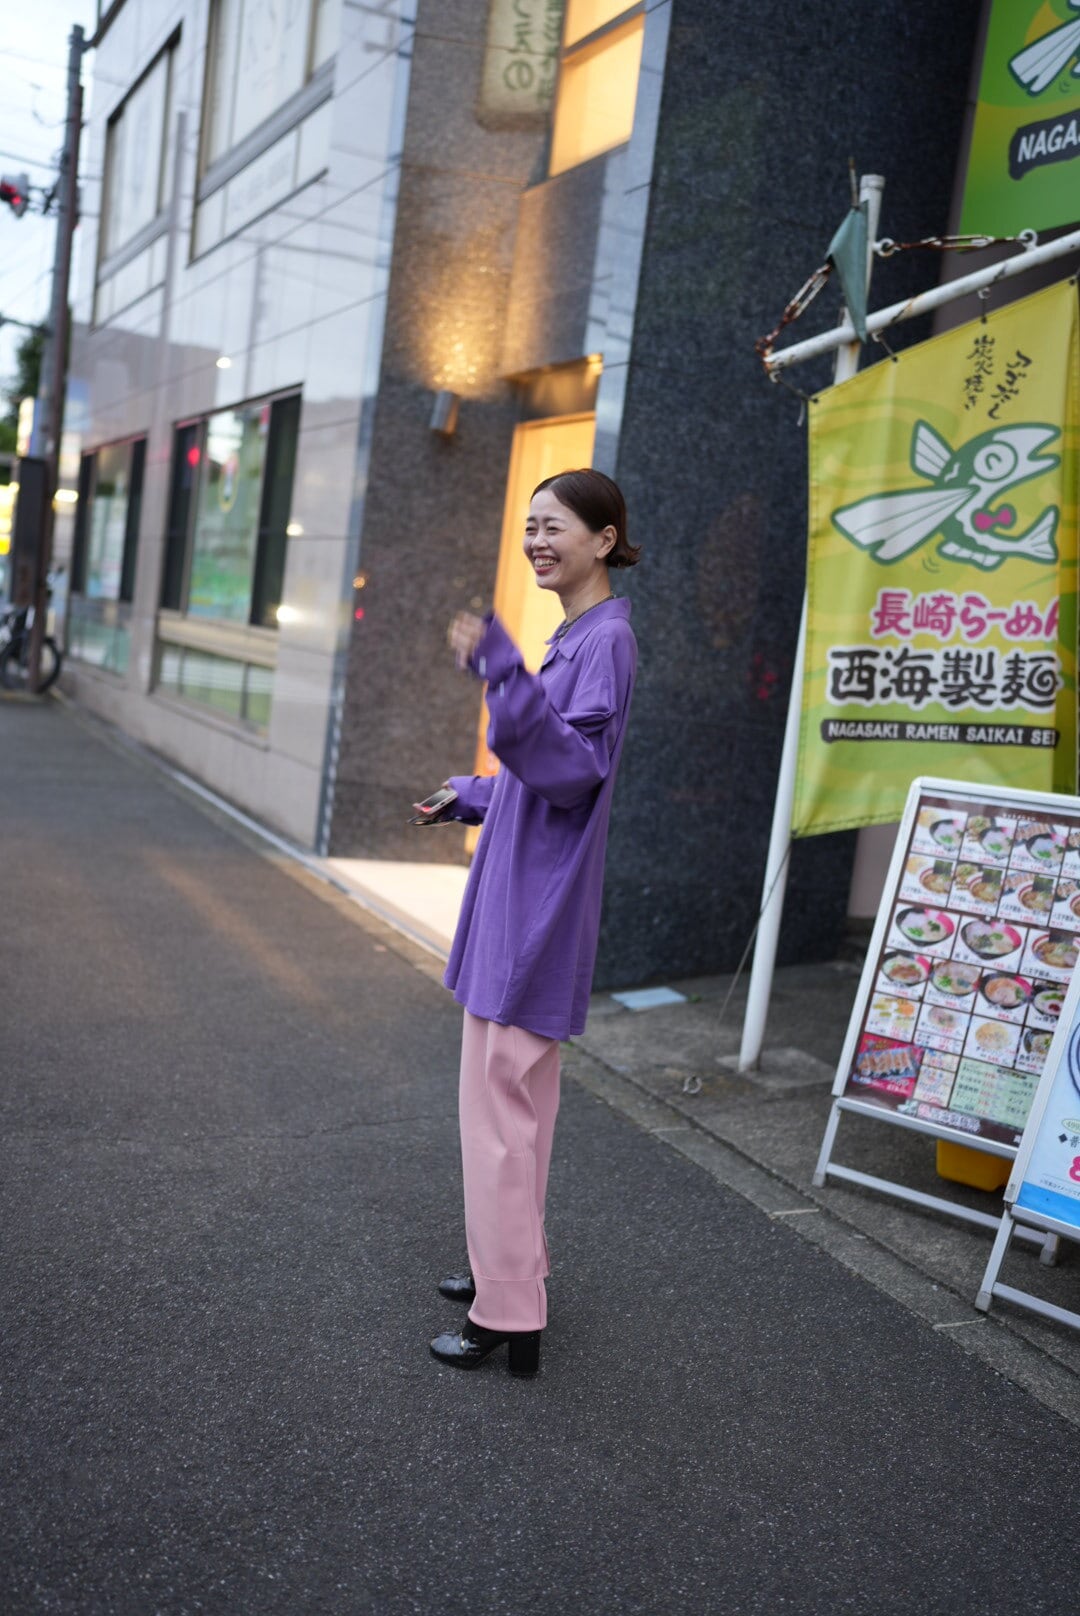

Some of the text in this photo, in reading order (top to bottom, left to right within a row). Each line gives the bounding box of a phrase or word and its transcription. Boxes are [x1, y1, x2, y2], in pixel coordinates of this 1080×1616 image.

[1017, 119, 1080, 163] NAGA
[828, 721, 899, 739] NAGASAKI
[906, 724, 960, 741] RAMEN
[966, 725, 1024, 745] SAIKAI
